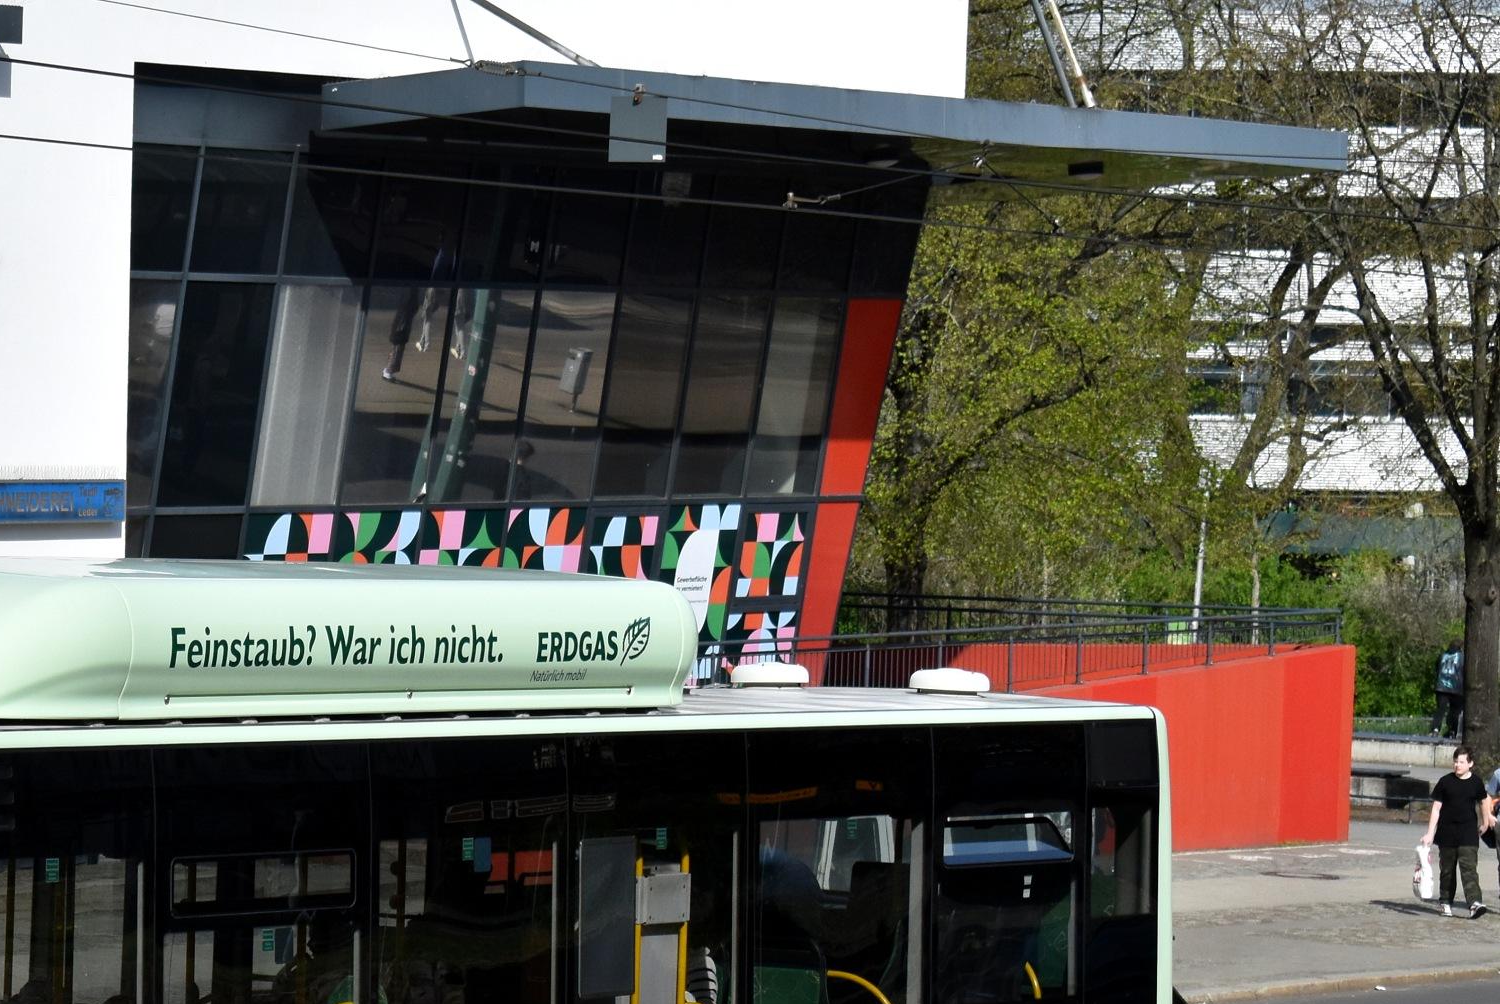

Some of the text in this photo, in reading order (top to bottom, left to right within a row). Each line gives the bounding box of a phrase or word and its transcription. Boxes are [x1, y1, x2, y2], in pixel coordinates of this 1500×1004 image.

[169, 624, 504, 669] Feinstaub? War ich nicht.
[536, 630, 618, 663] ERDGAS
[530, 668, 587, 682] Natürlich mobil
